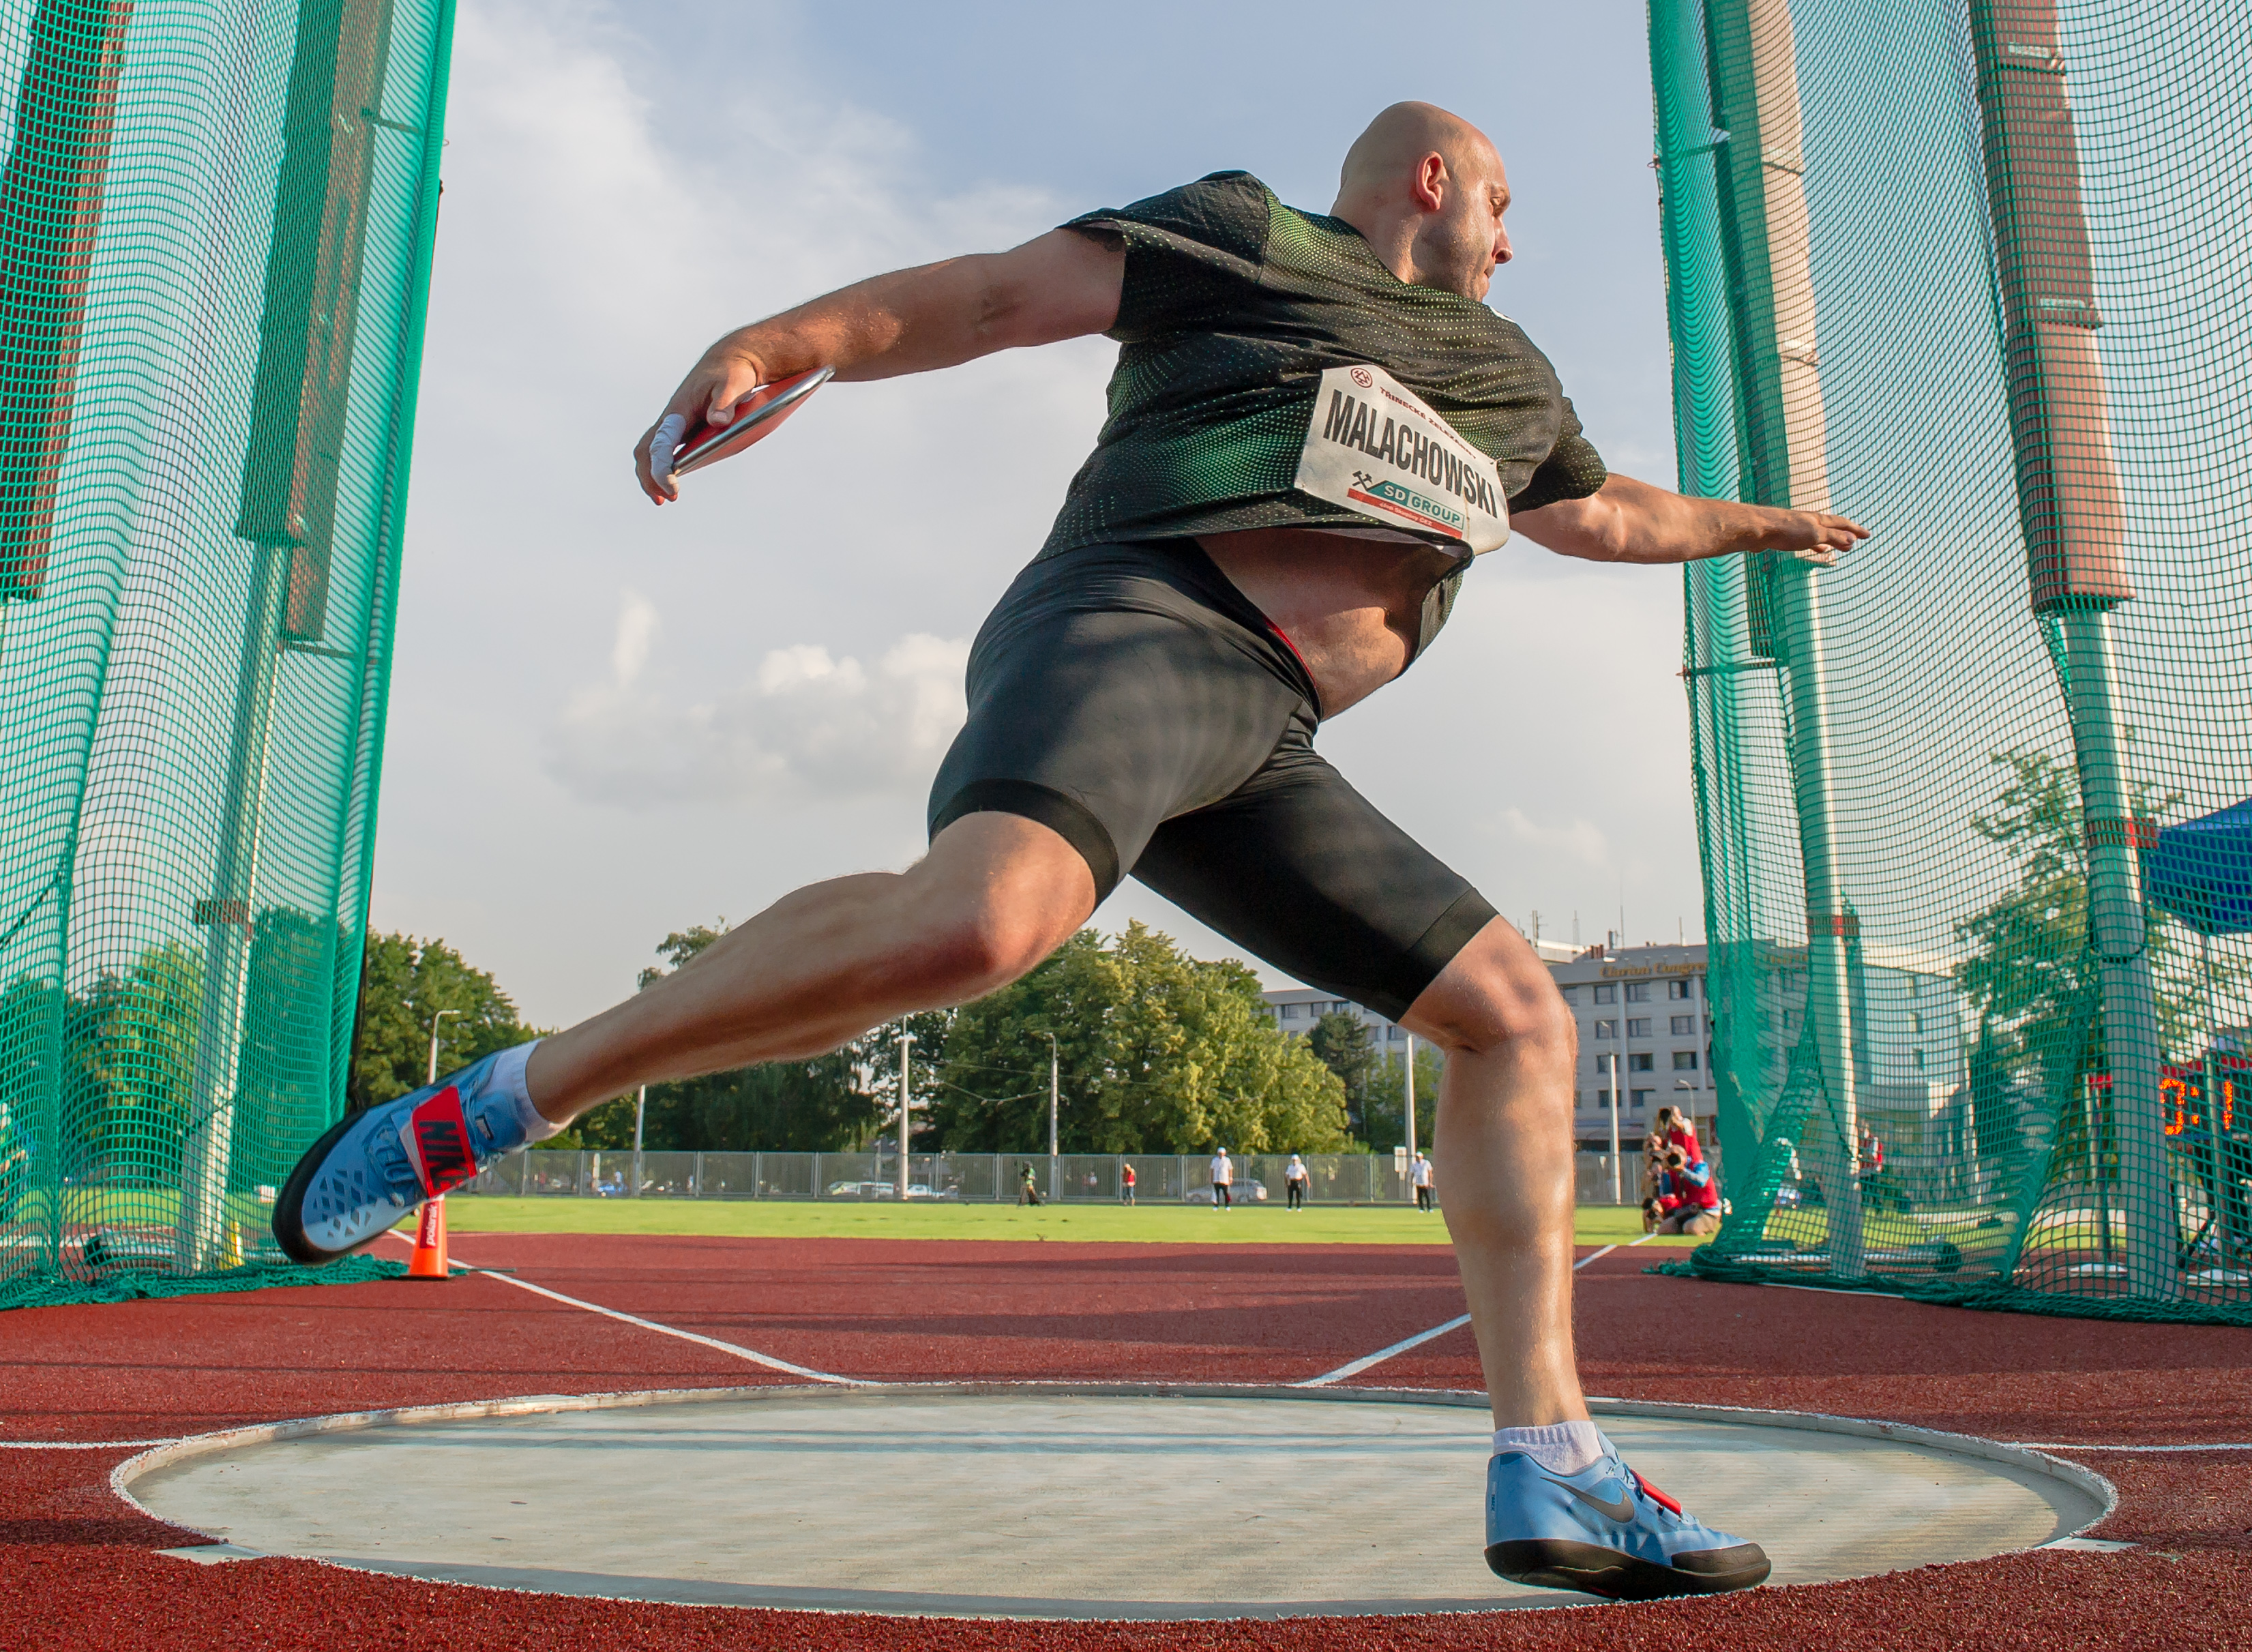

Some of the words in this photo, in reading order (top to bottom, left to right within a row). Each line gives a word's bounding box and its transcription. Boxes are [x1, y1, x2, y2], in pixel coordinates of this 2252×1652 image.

[1323, 388, 1498, 518] MALACHOWSKI
[1384, 485, 1406, 501] SD
[1411, 496, 1460, 523] GROUP
